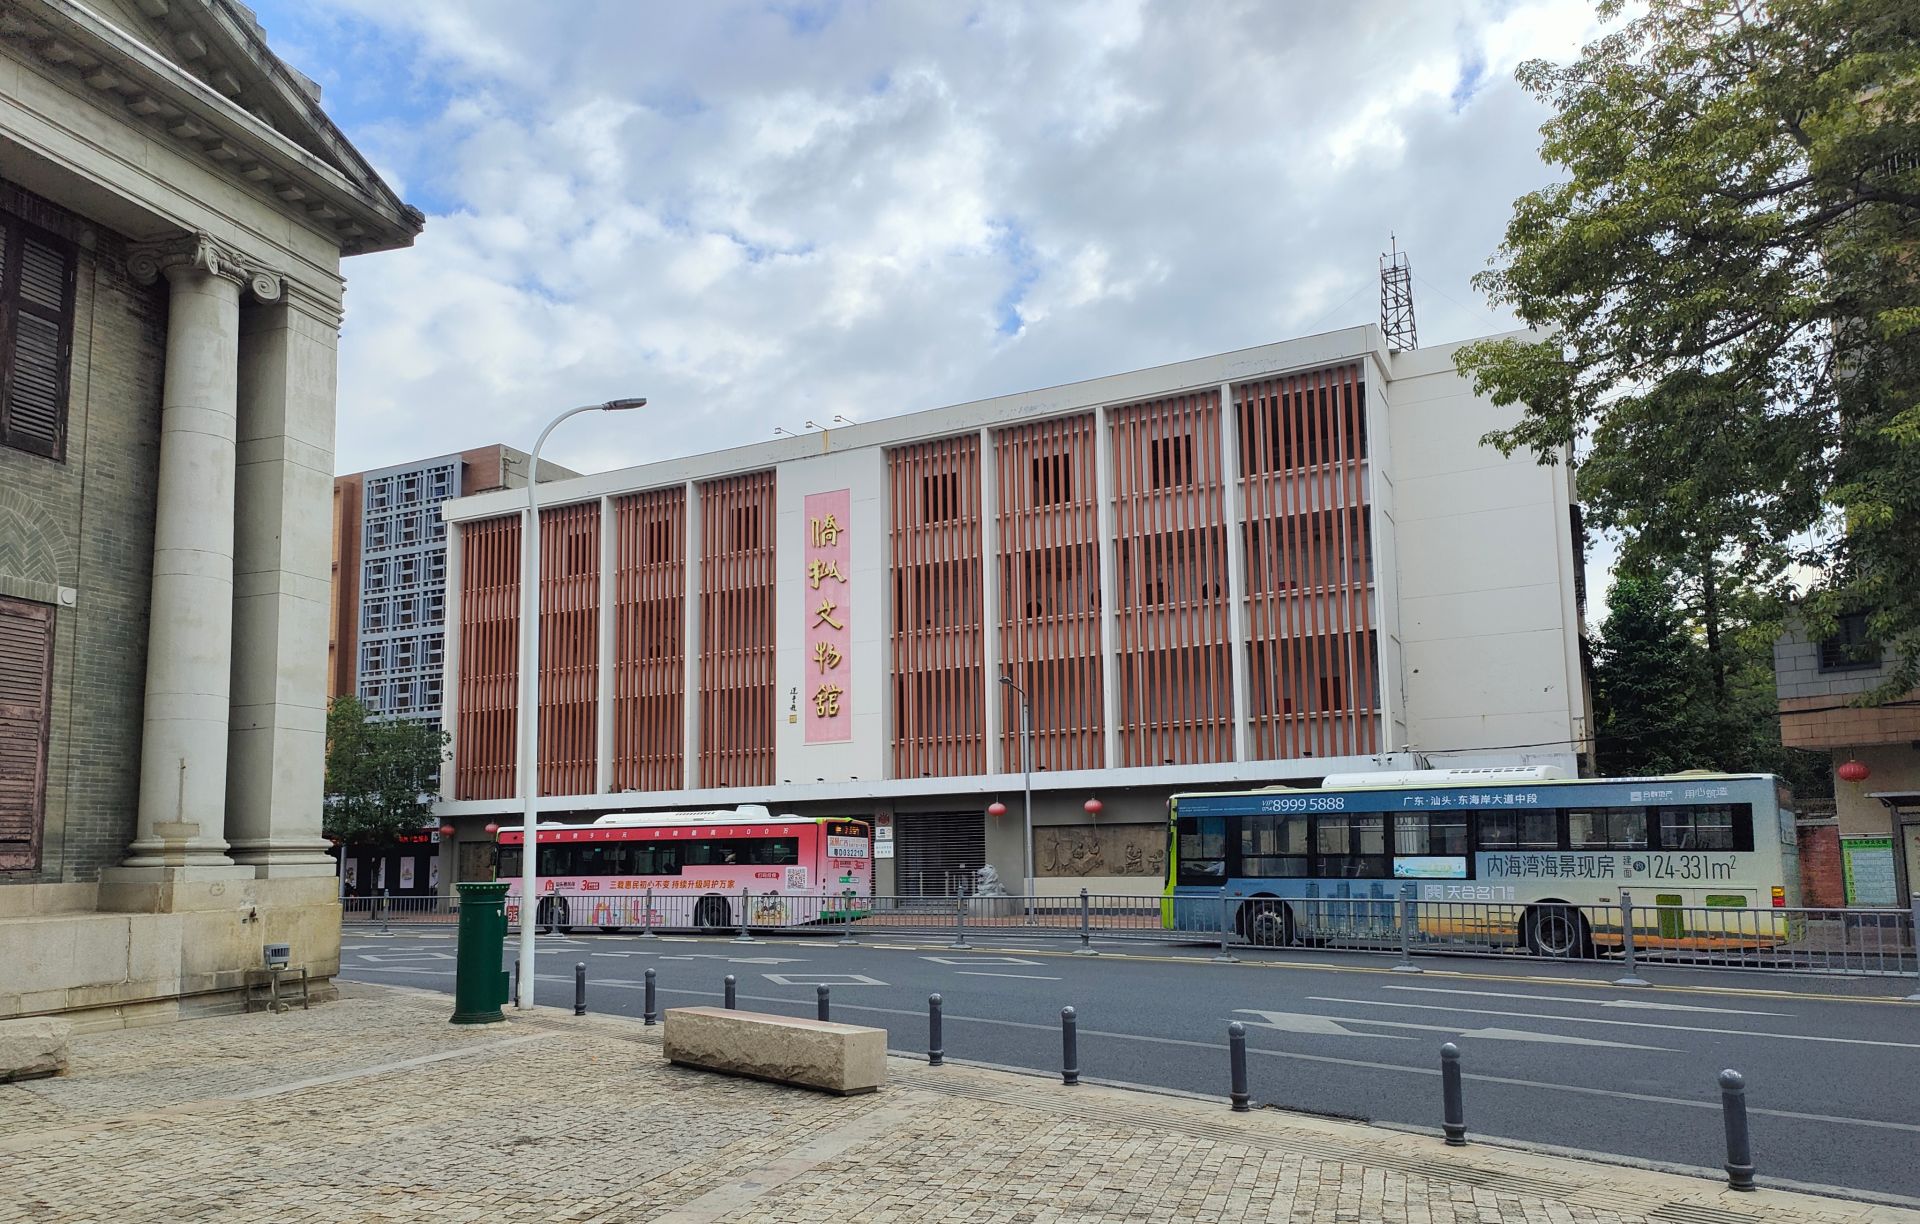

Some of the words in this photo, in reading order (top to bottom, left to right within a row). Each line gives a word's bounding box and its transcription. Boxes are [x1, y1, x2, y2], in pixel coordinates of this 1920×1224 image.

[1272, 798, 1307, 812] 8999
[1309, 797, 1345, 811] 5888
[1403, 793, 1538, 806] 广东·汕头·东海岸大道中段
[1487, 855, 1615, 878] 内海湾海景现房
[1447, 885, 1505, 900] 天合名门
